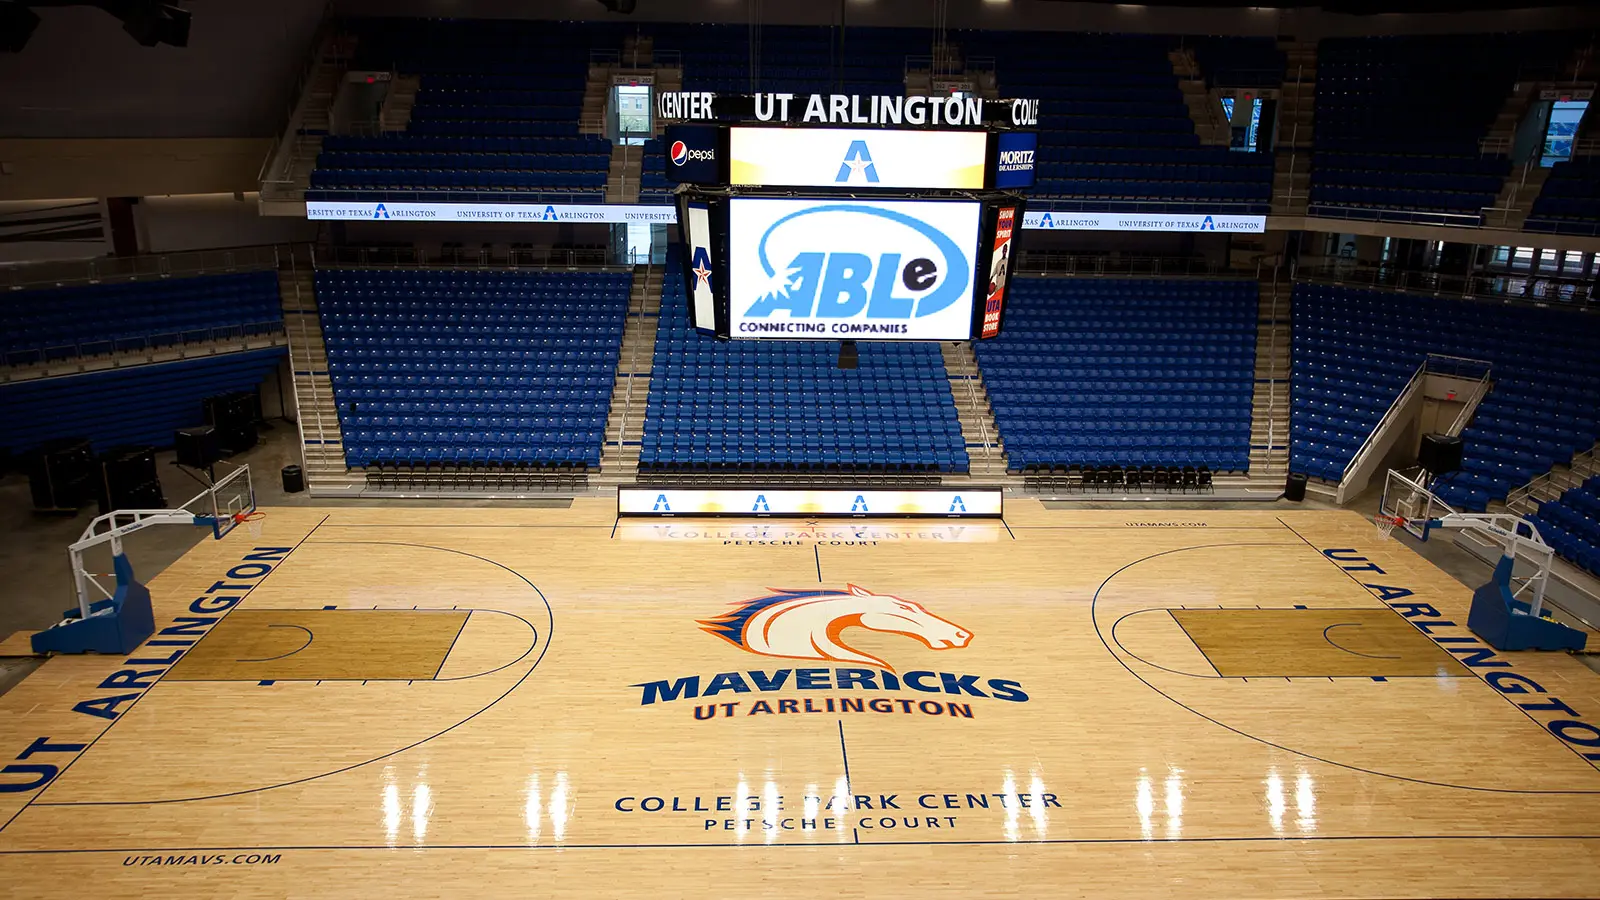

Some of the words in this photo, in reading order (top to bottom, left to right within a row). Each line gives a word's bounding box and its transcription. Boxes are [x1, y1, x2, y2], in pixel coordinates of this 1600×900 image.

[754, 92, 793, 122] UT
[803, 94, 983, 126] ARLINGTON
[688, 148, 715, 161] pepsi
[999, 150, 1034, 165] MORITZ
[999, 163, 1034, 172] DEALERSHIPS
[518, 211, 542, 219] TEXAS
[999, 209, 1014, 219] SHOW
[1055, 219, 1100, 227] ARLINGTON
[1118, 220, 1163, 228] UNIVERSITY
[1177, 221, 1199, 229] TEXAS
[996, 229, 1012, 239] SPIRIT
[986, 299, 1000, 312] UTA
[985, 311, 999, 322] BOOK
[739, 322, 826, 333] CONNECTING
[831, 323, 908, 334] COMPANIES
[983, 321, 998, 332] STORE
[785, 531, 845, 539] PARK
[855, 531, 945, 539] CENTER
[1323, 548, 1387, 575] UT
[1363, 583, 1600, 761] ARLINGTO
[0, 736, 88, 794] UT
[71, 547, 294, 720] ARLINGTON
[627, 668, 1030, 706] MAVERICKS
[693, 701, 741, 721] UT
[747, 698, 975, 720] ARLINGTON
[918, 793, 1062, 809] CENTER
[704, 818, 836, 831] PETSCHE
[859, 817, 958, 829] COURT
[123, 854, 282, 867] UTAMAVS.COM
